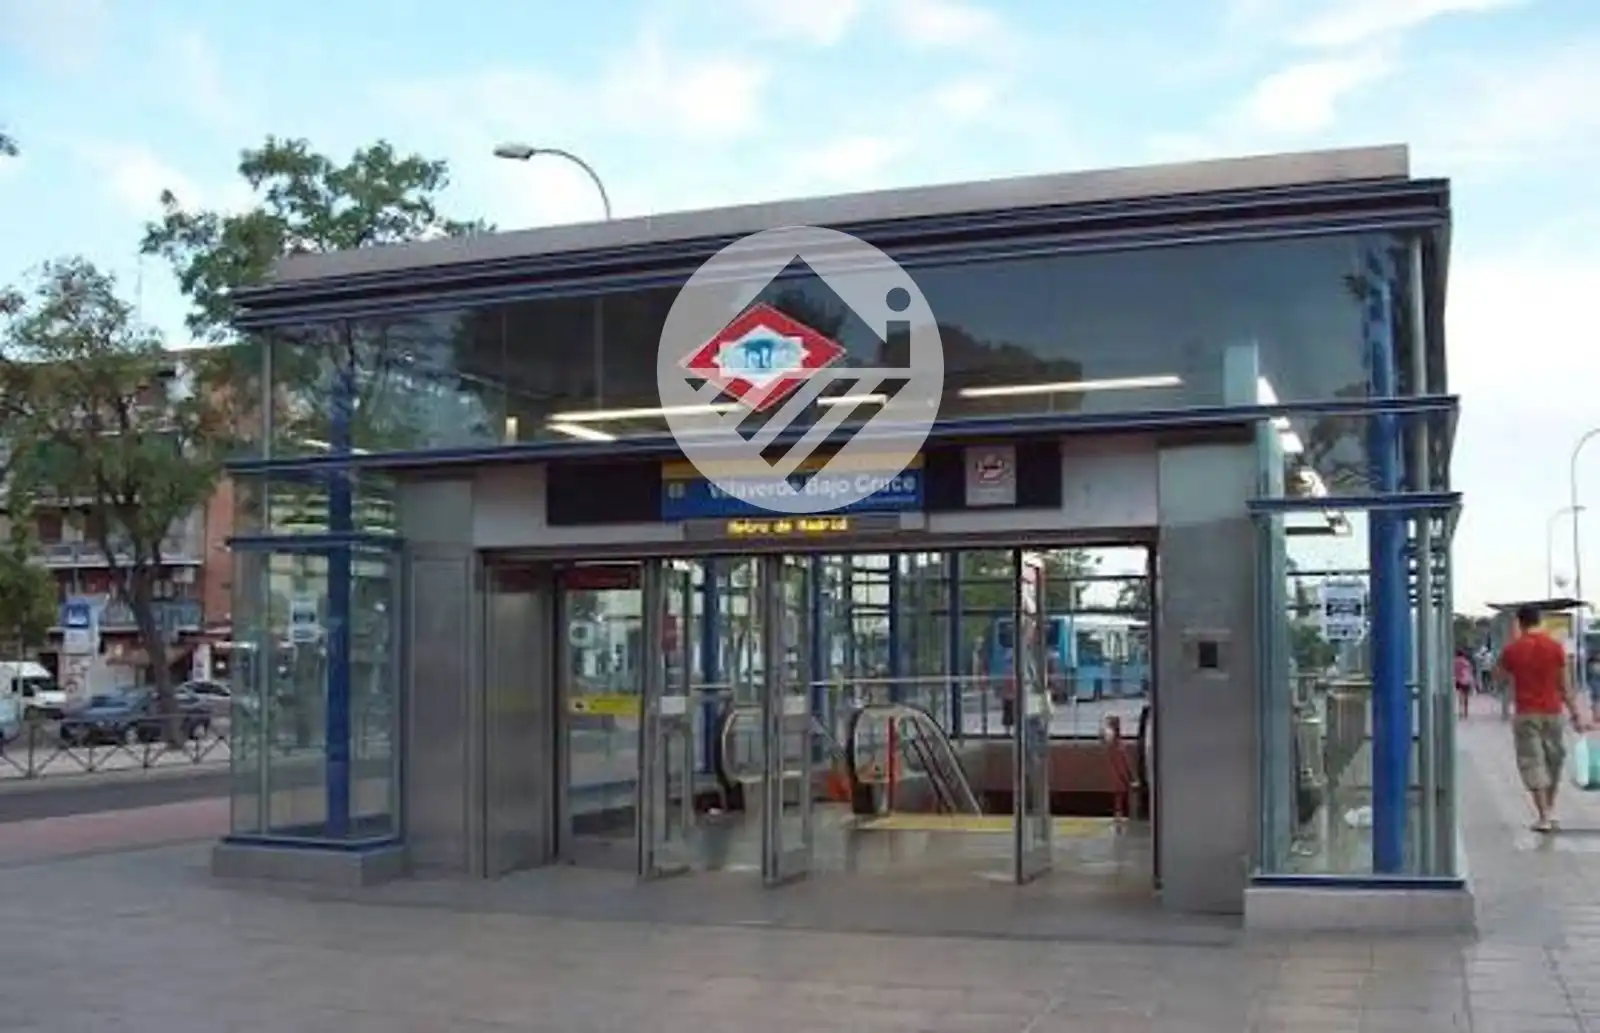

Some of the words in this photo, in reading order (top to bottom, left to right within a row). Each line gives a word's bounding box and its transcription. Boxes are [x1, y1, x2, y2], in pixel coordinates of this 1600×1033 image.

[804, 475, 850, 499] Bajo
[853, 473, 917, 493] Cruce
[773, 519, 793, 533] de
[797, 517, 847, 531] Madrid
